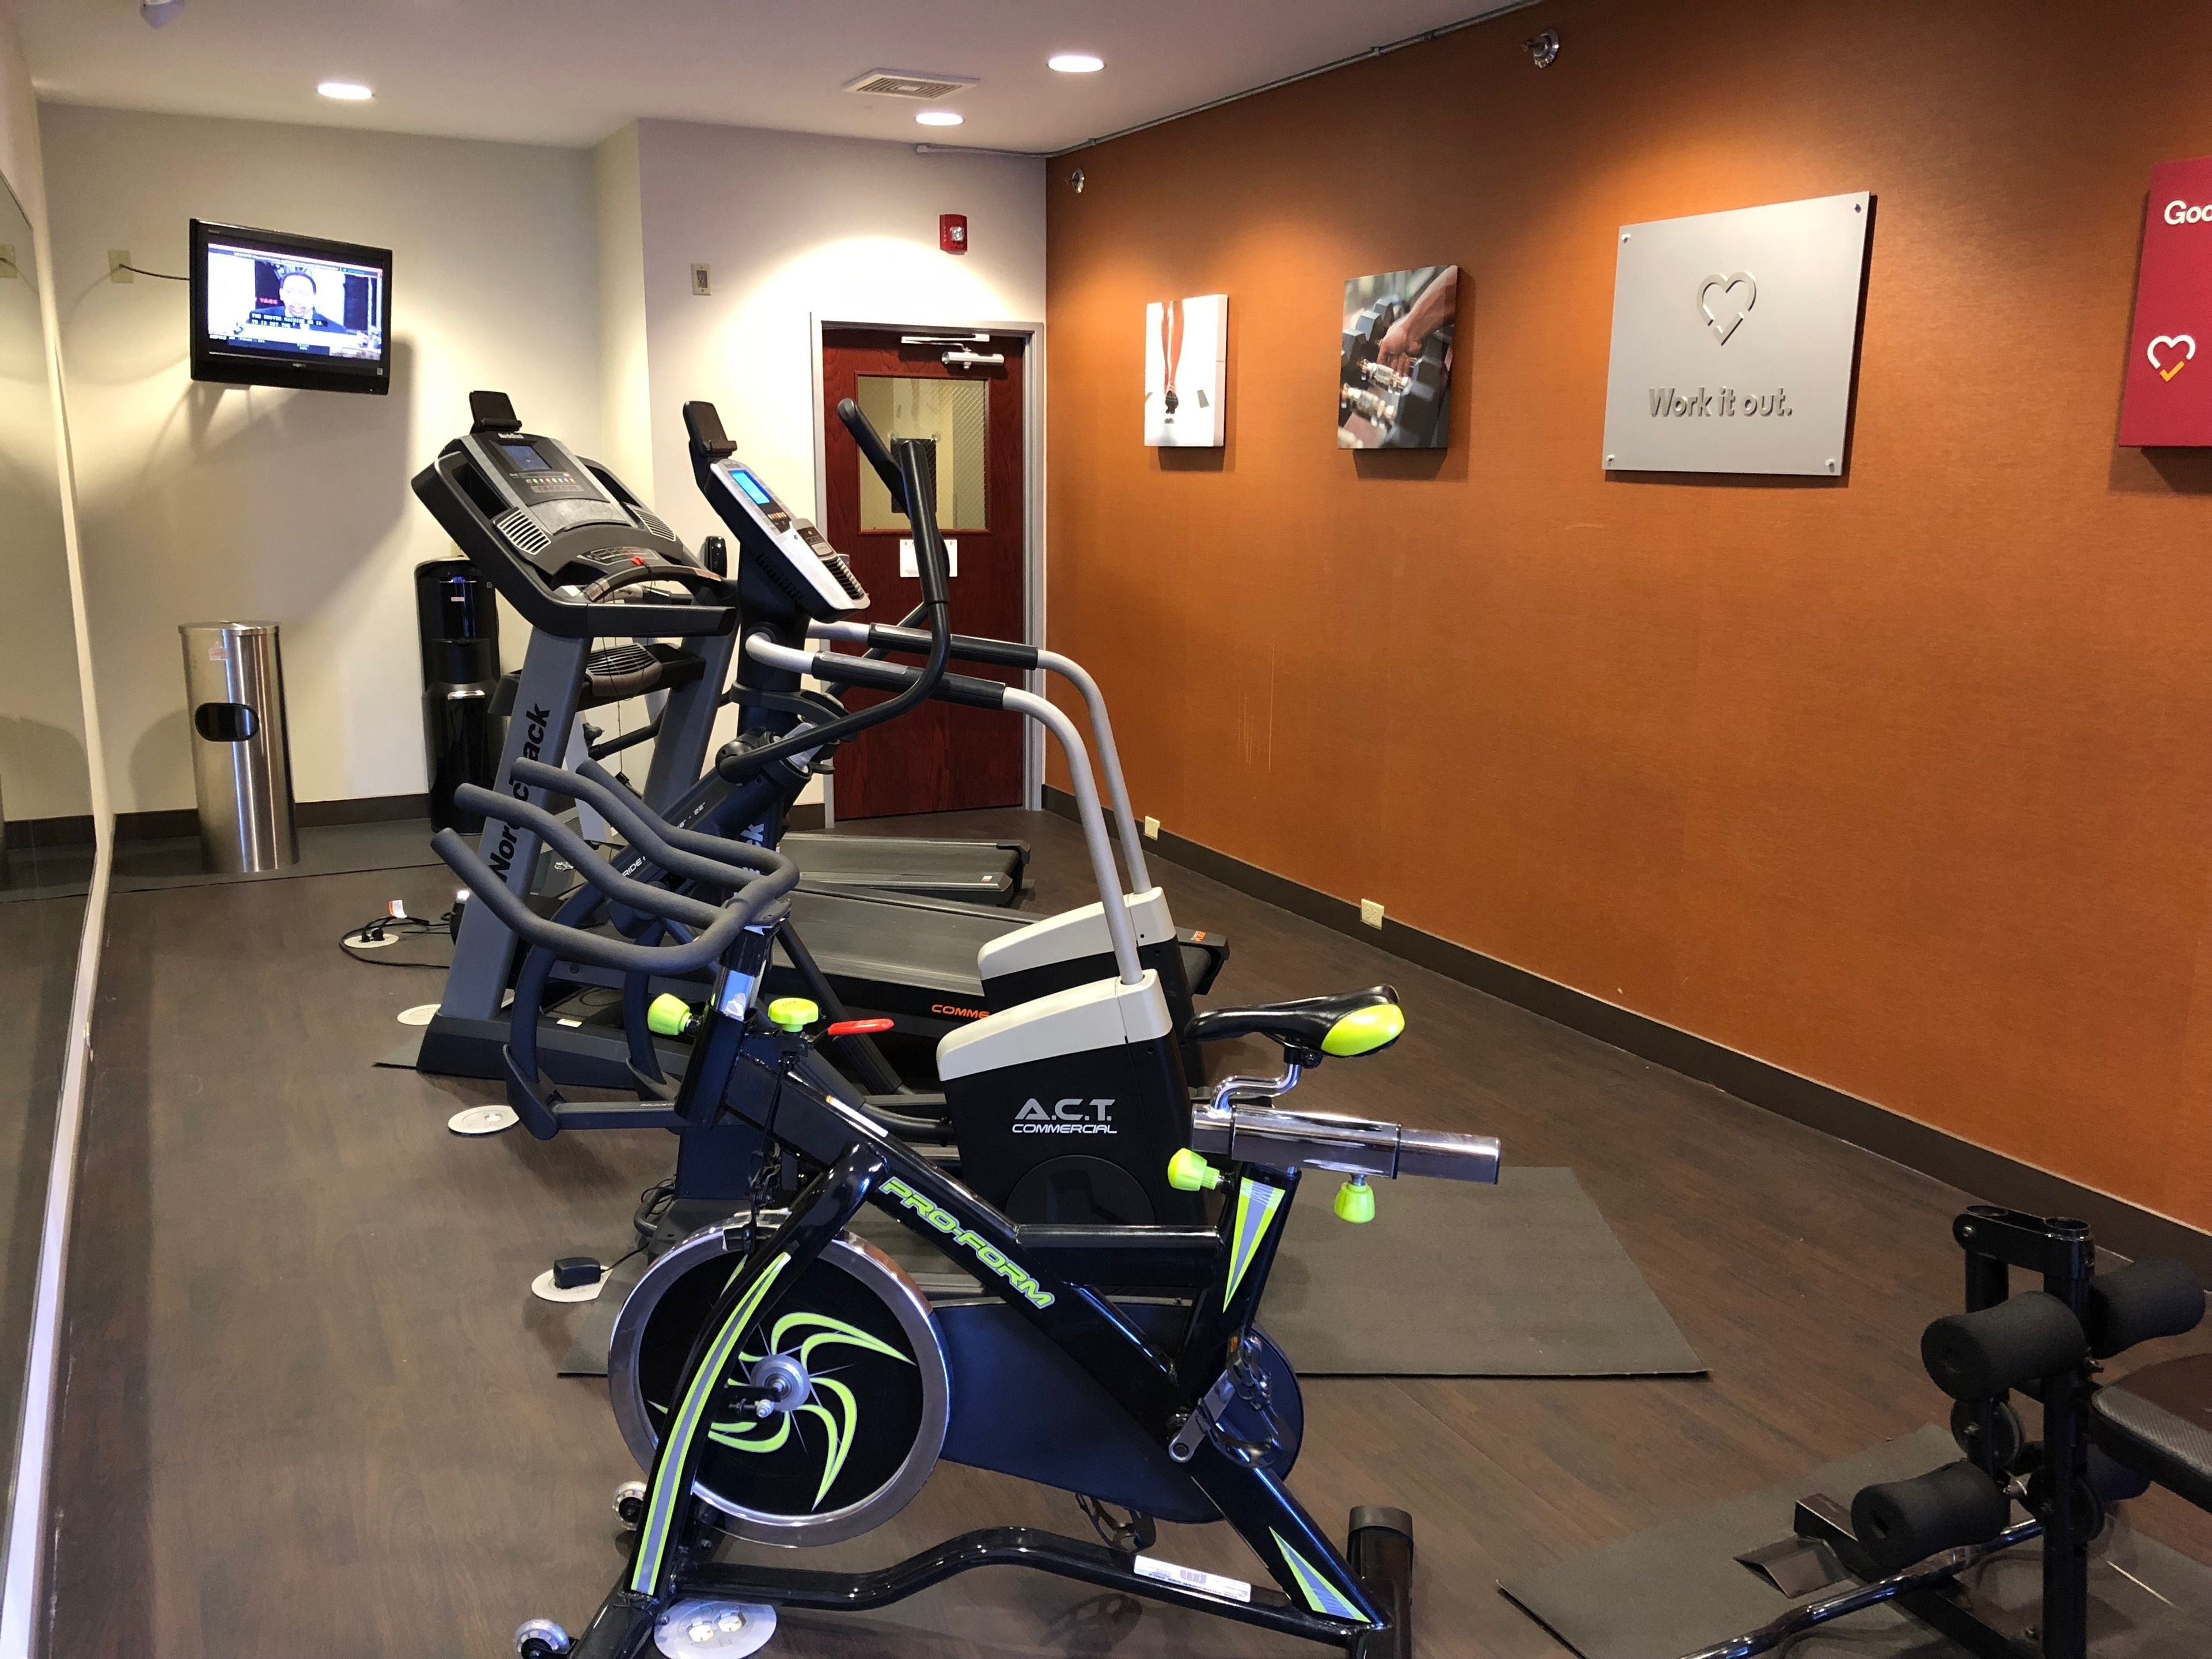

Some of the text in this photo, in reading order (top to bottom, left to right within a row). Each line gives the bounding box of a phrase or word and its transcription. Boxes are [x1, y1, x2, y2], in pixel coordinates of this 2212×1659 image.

[2164, 200, 2212, 225] Goo
[1649, 386, 1793, 417] Work it out.
[622, 857, 642, 876] RIDE
[931, 1004, 990, 1018] COMME
[1014, 1098, 1116, 1121] A.C.T.
[1012, 1124, 1118, 1134] COMMERCIAL
[880, 1177, 1055, 1308] PRO-FORM
